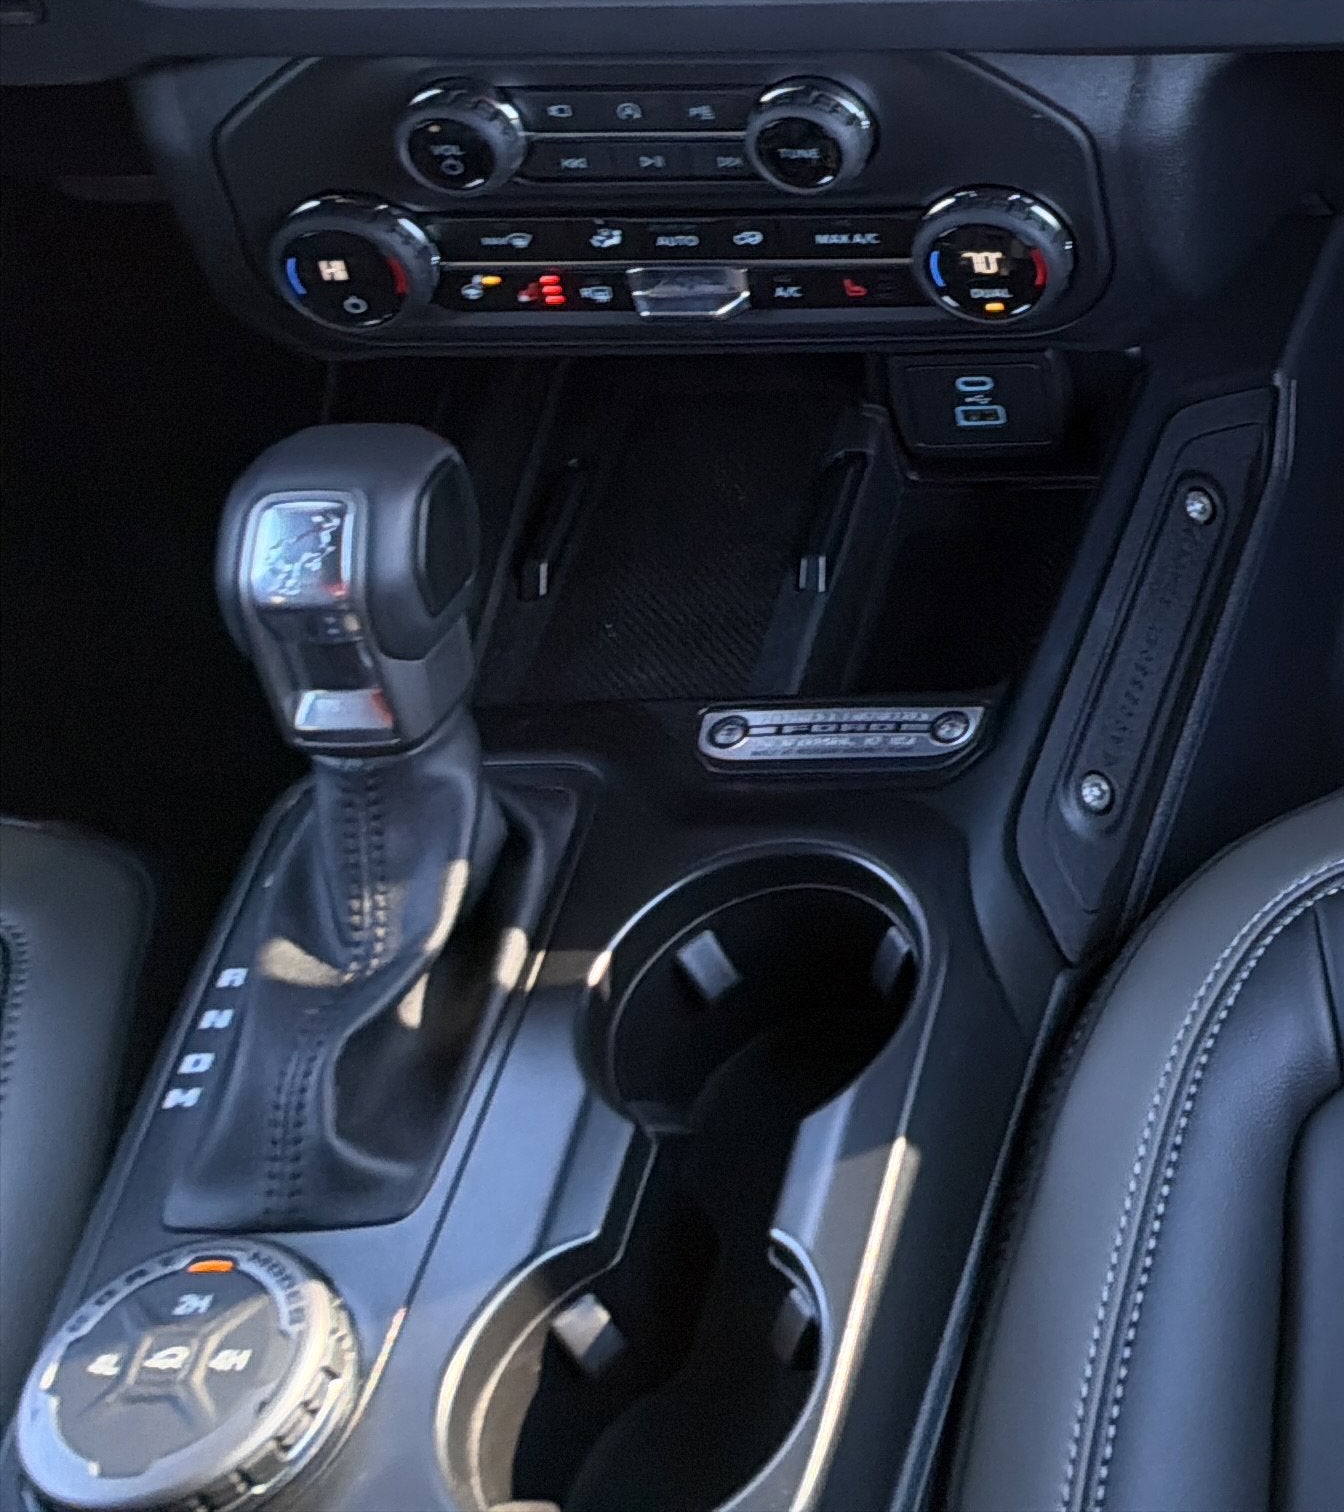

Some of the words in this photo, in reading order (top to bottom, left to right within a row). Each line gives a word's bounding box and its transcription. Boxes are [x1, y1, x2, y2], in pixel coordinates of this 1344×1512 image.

[778, 148, 821, 160] TUNE
[656, 236, 699, 246] AUTO
[215, 967, 249, 988] R
[198, 1009, 234, 1029] N
[177, 1053, 216, 1074] D
[172, 1293, 215, 1316] 2H
